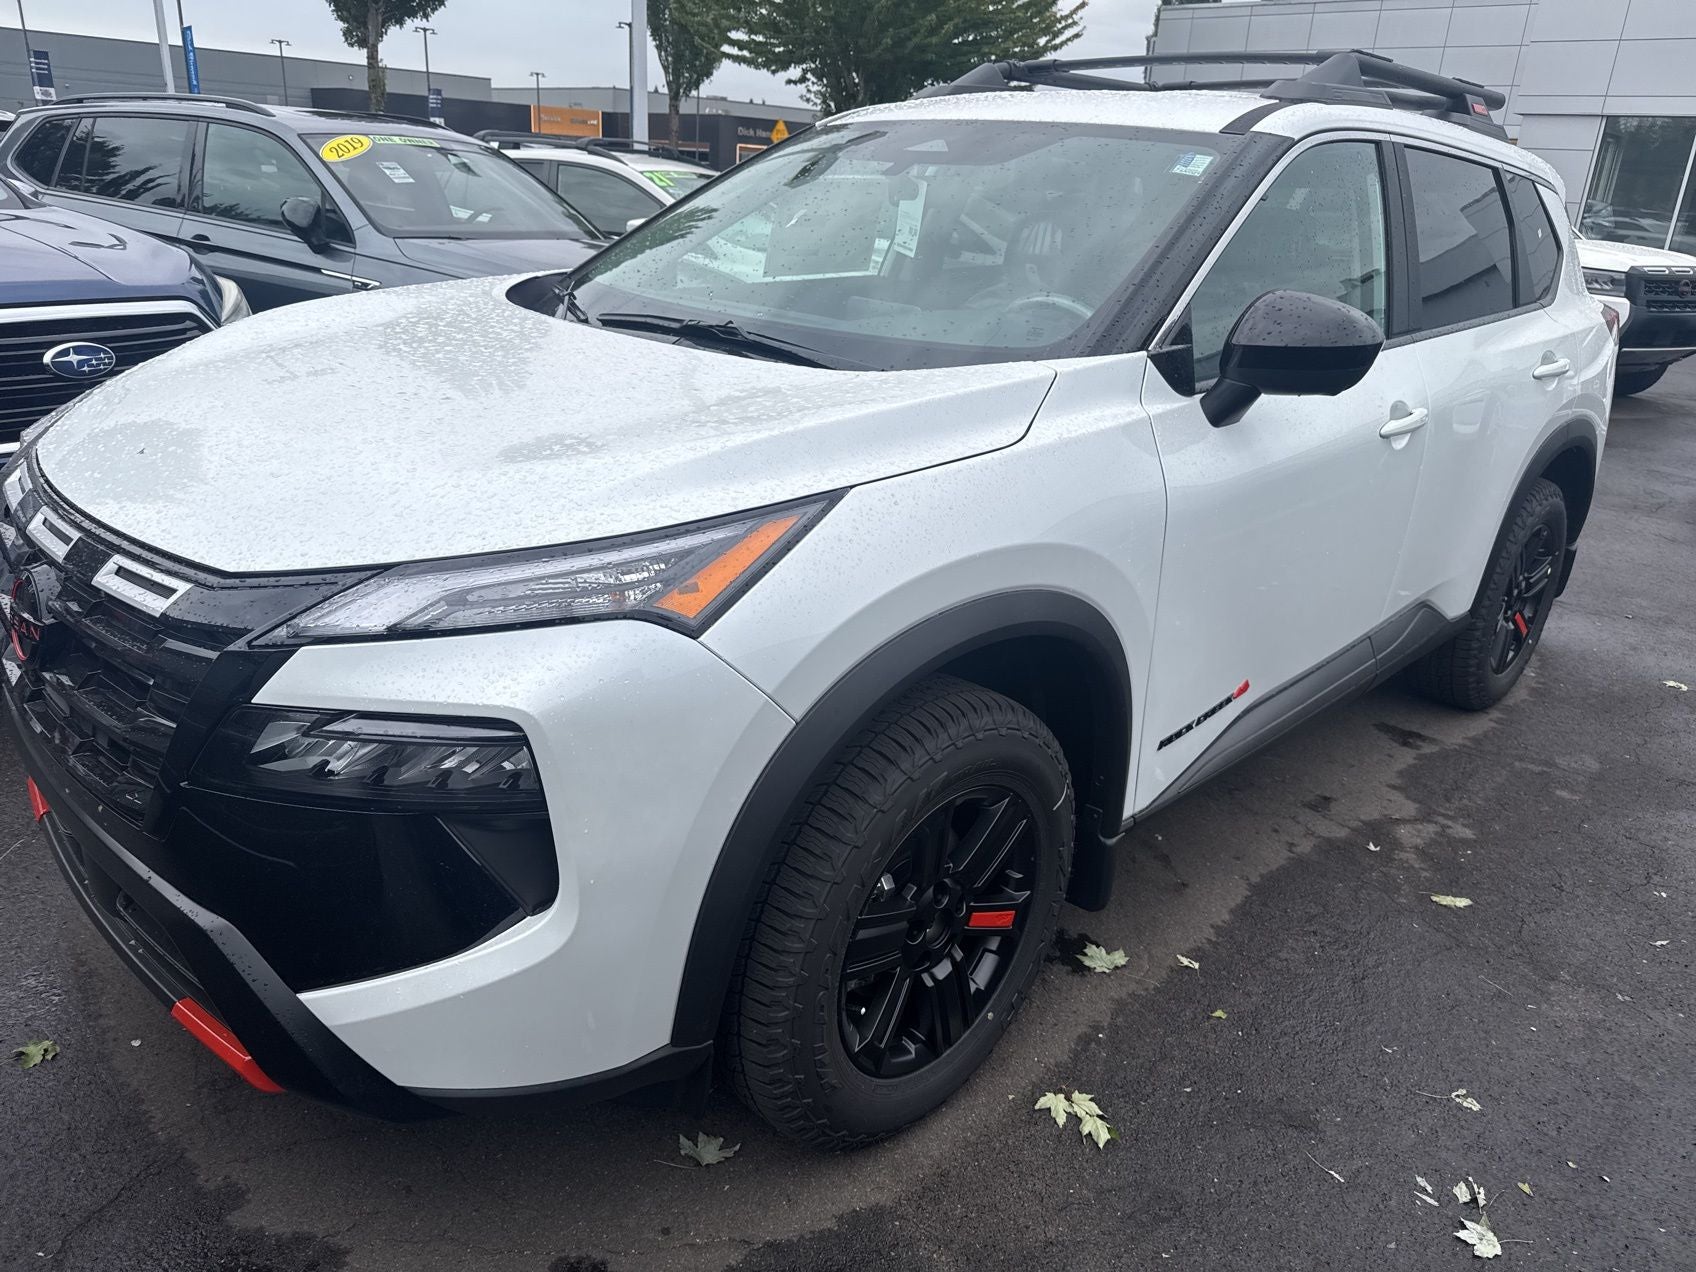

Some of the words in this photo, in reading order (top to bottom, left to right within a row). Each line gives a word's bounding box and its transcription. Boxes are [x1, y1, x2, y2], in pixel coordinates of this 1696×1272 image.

[737, 126, 755, 136] Dick
[755, 128, 772, 137] Han
[329, 136, 364, 159] 2019
